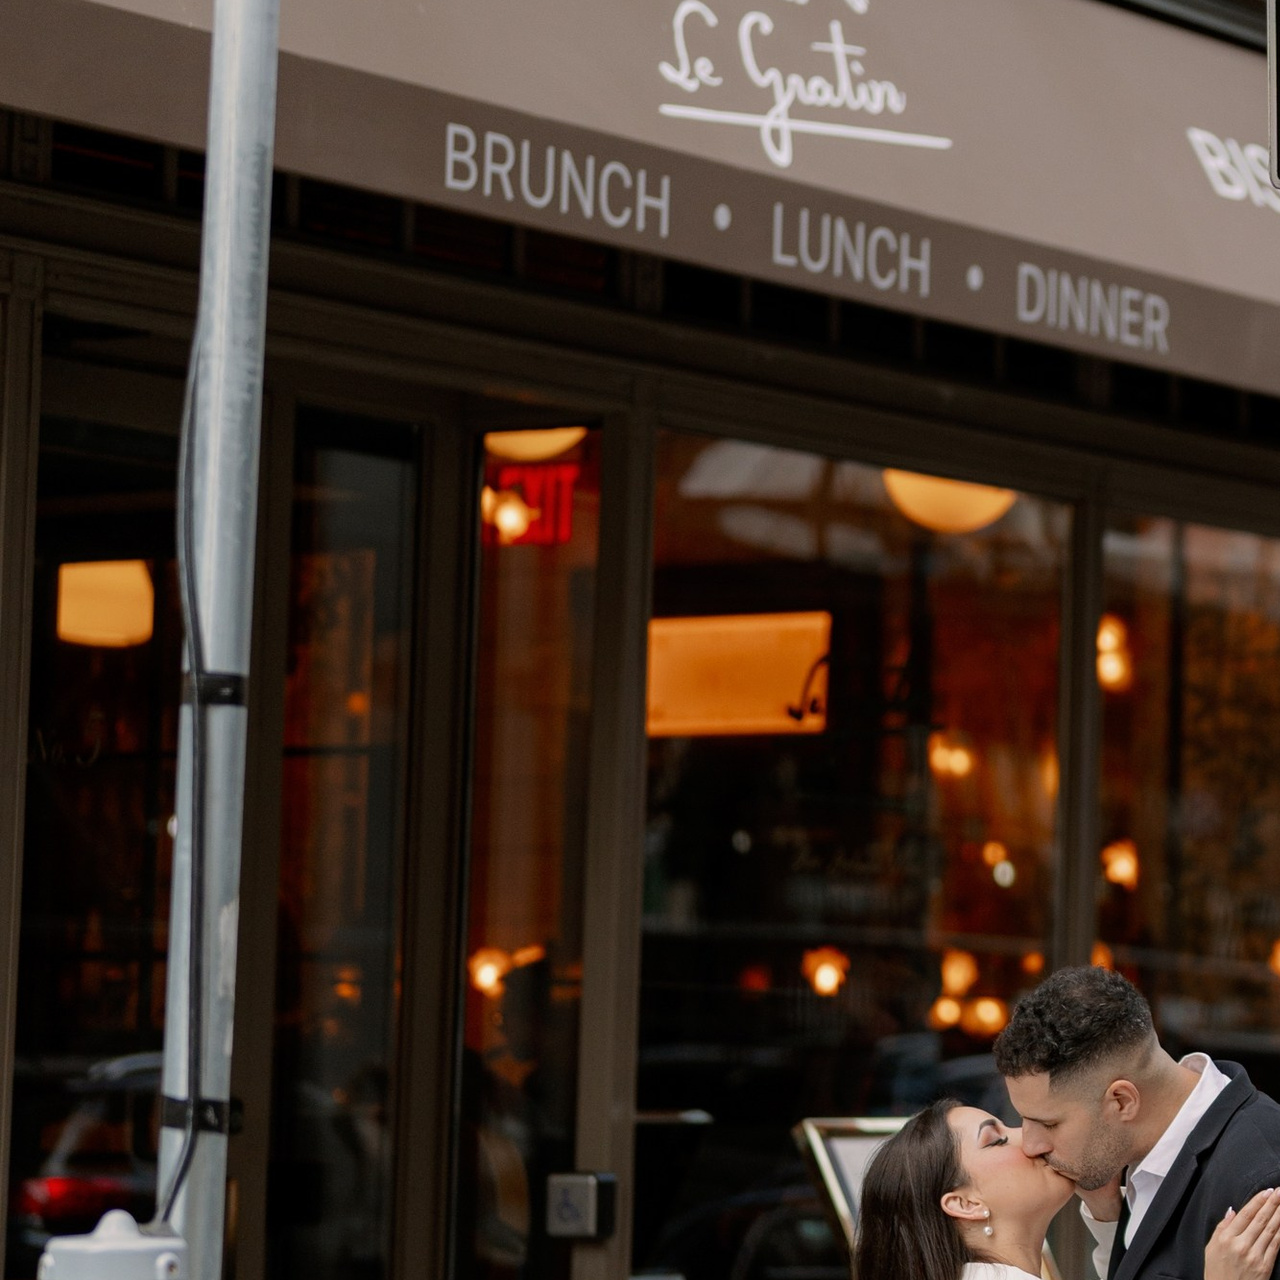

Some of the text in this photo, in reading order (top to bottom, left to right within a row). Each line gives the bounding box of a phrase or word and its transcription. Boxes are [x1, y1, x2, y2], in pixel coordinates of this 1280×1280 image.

[659, 0, 906, 168] Le Gratin
[445, 122, 1169, 354] BRUNCH LUNCH DINNER
